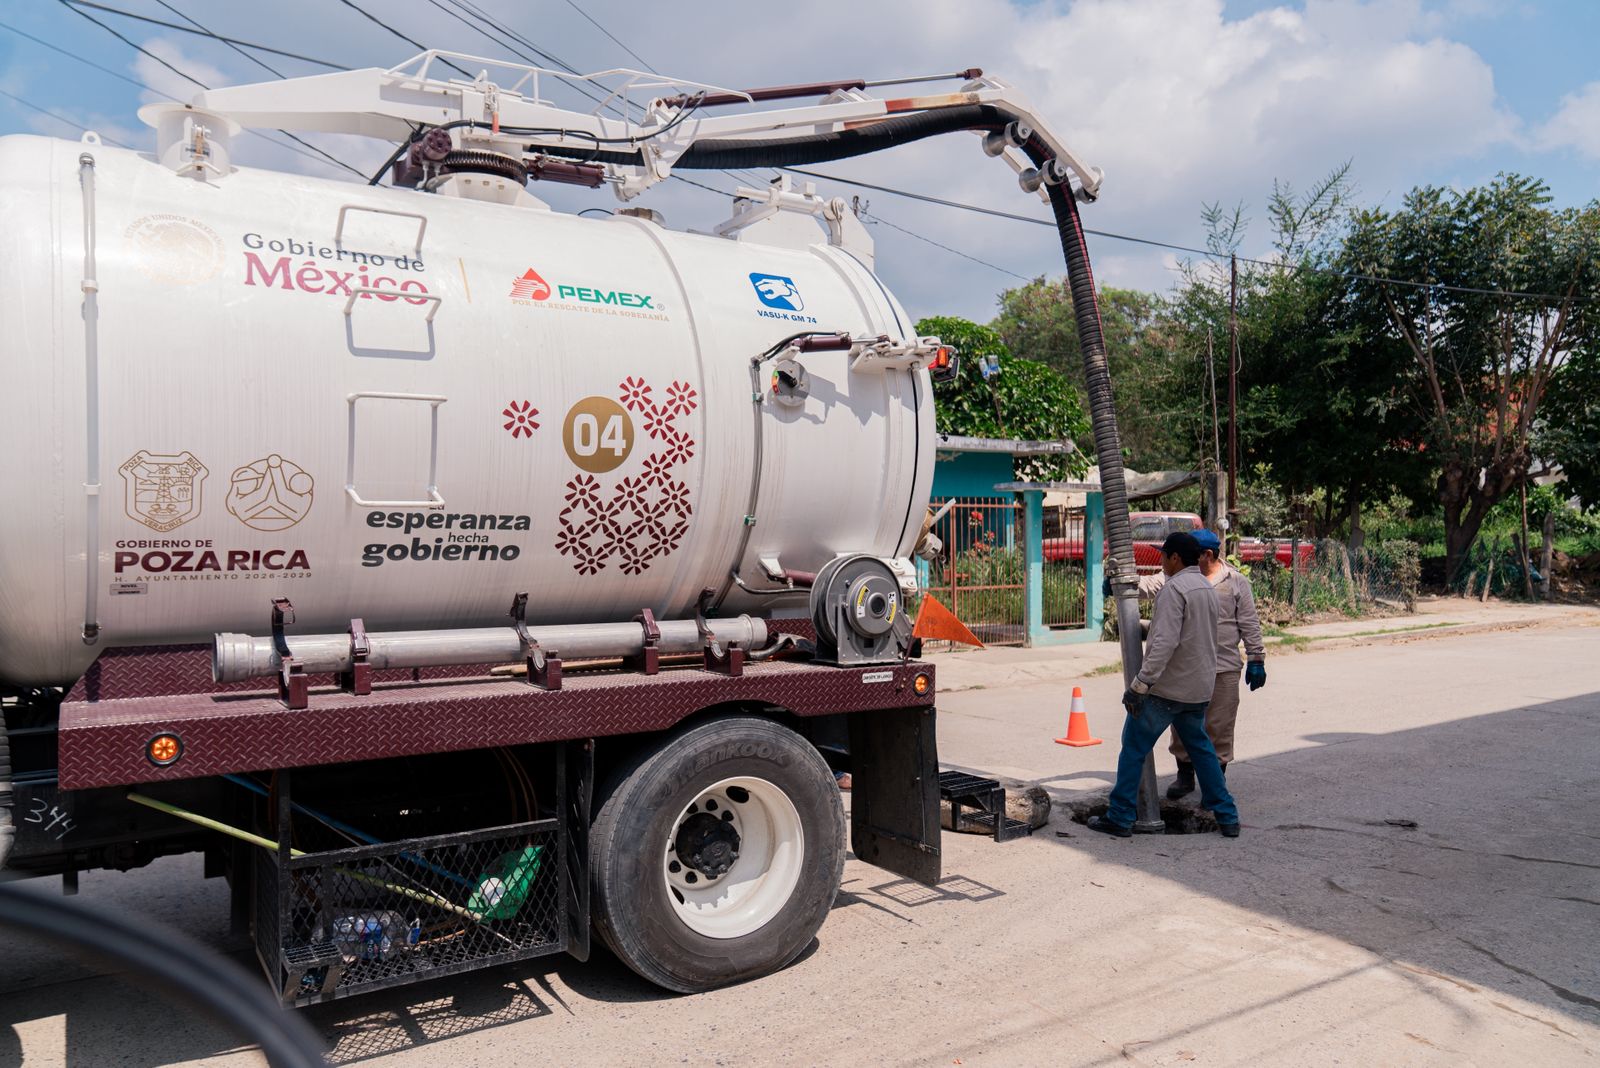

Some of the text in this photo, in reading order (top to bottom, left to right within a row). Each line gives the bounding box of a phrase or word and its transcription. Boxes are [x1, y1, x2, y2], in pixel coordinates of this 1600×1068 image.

[242, 232, 425, 273] Gobierno de
[242, 251, 430, 306] México
[557, 284, 655, 310] PEMEX
[512, 299, 532, 307] POR
[533, 301, 546, 309] EL
[548, 303, 590, 313] RESCATE
[619, 309, 671, 322] SOBERANÍA
[757, 310, 818, 324] VASU-K GM 74
[573, 413, 626, 457] 04
[123, 455, 203, 472] POZA RICA
[143, 517, 184, 531] VERACRUZ
[366, 510, 531, 535] esperanza
[115, 539, 213, 549] GOBIERNO DE
[447, 531, 489, 544] hecha
[114, 549, 310, 573] POZA RICA
[361, 537, 520, 567] gobierno
[135, 573, 239, 583] AYUNTAMIENTO
[245, 571, 312, 580] 2026-2029
